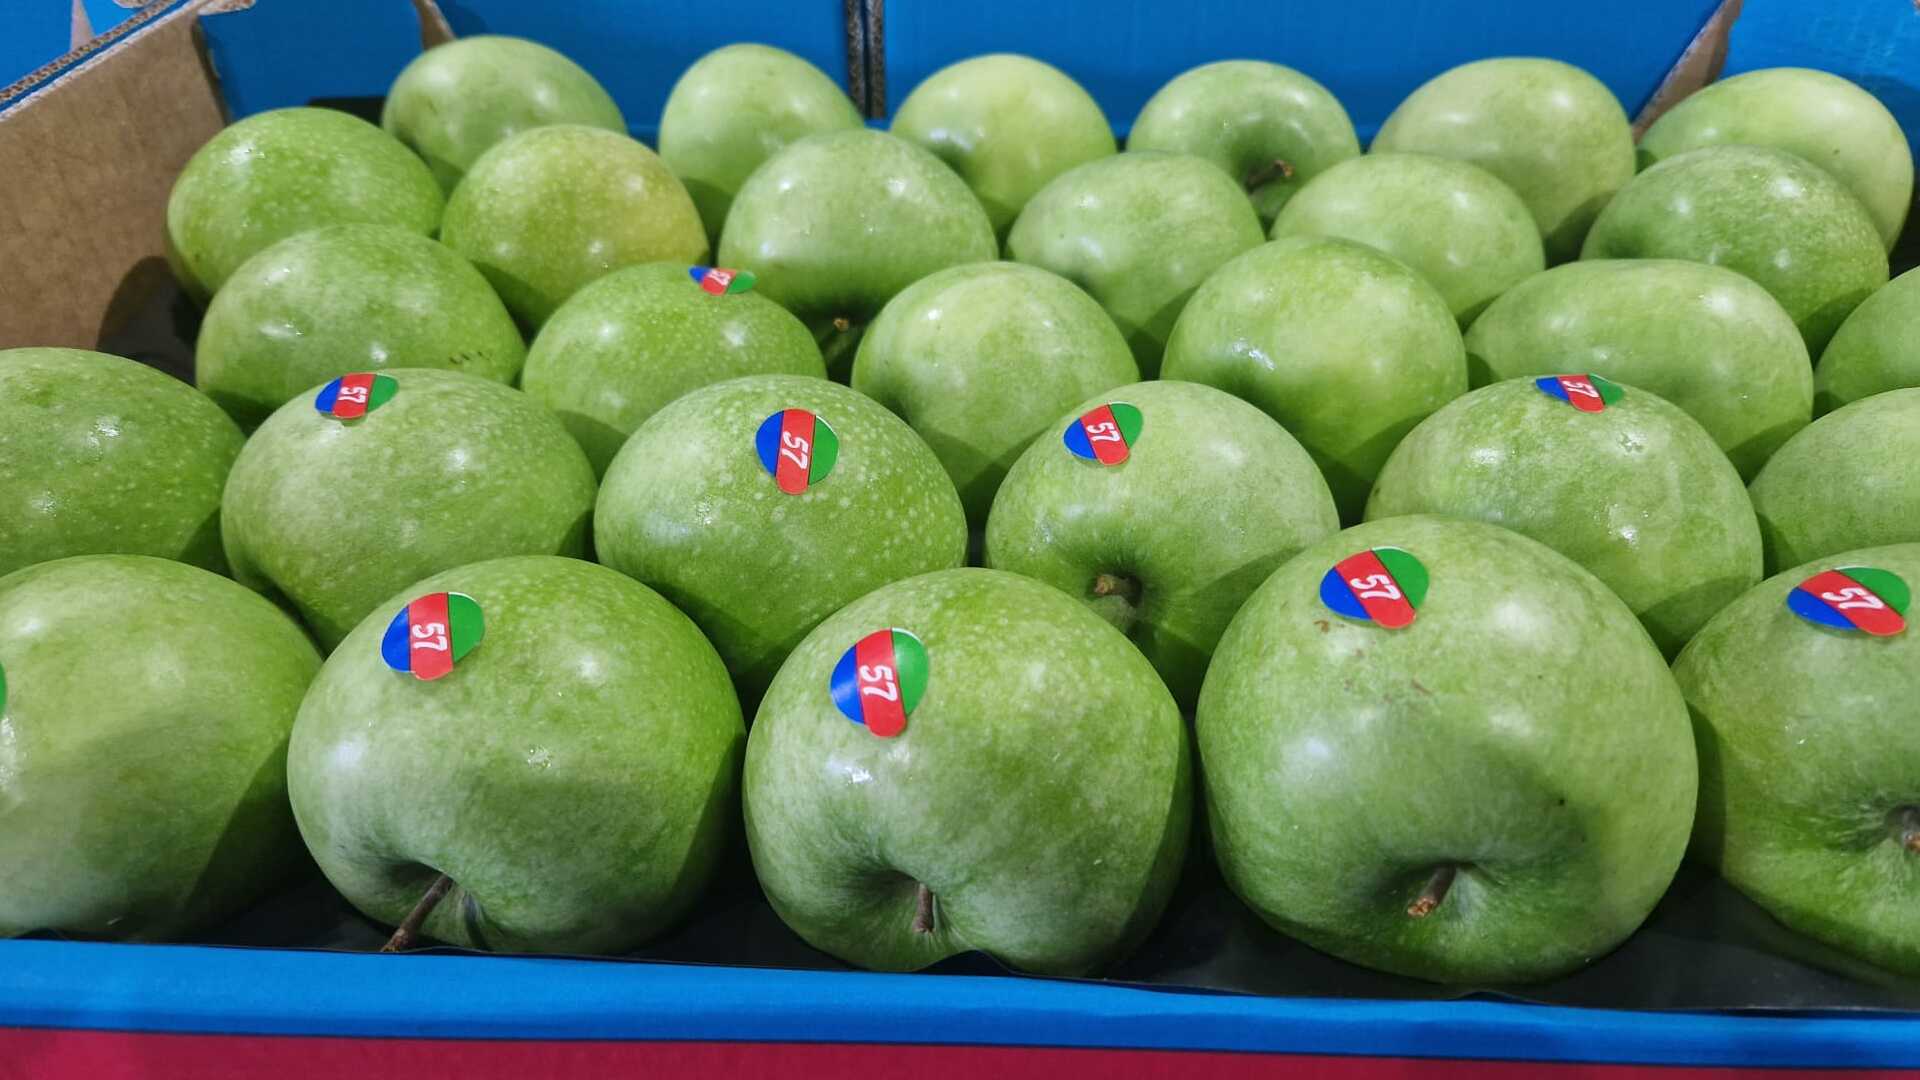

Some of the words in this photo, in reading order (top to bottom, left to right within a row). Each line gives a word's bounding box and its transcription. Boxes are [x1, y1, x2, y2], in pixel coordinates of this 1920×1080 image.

[338, 387, 367, 403] 57
[1561, 380, 1599, 399] 57
[1087, 421, 1120, 442] 57
[782, 431, 809, 470] 57
[1350, 574, 1401, 600] 57
[1821, 587, 1884, 609] 57
[411, 623, 447, 651] 57
[859, 664, 898, 702] 57
